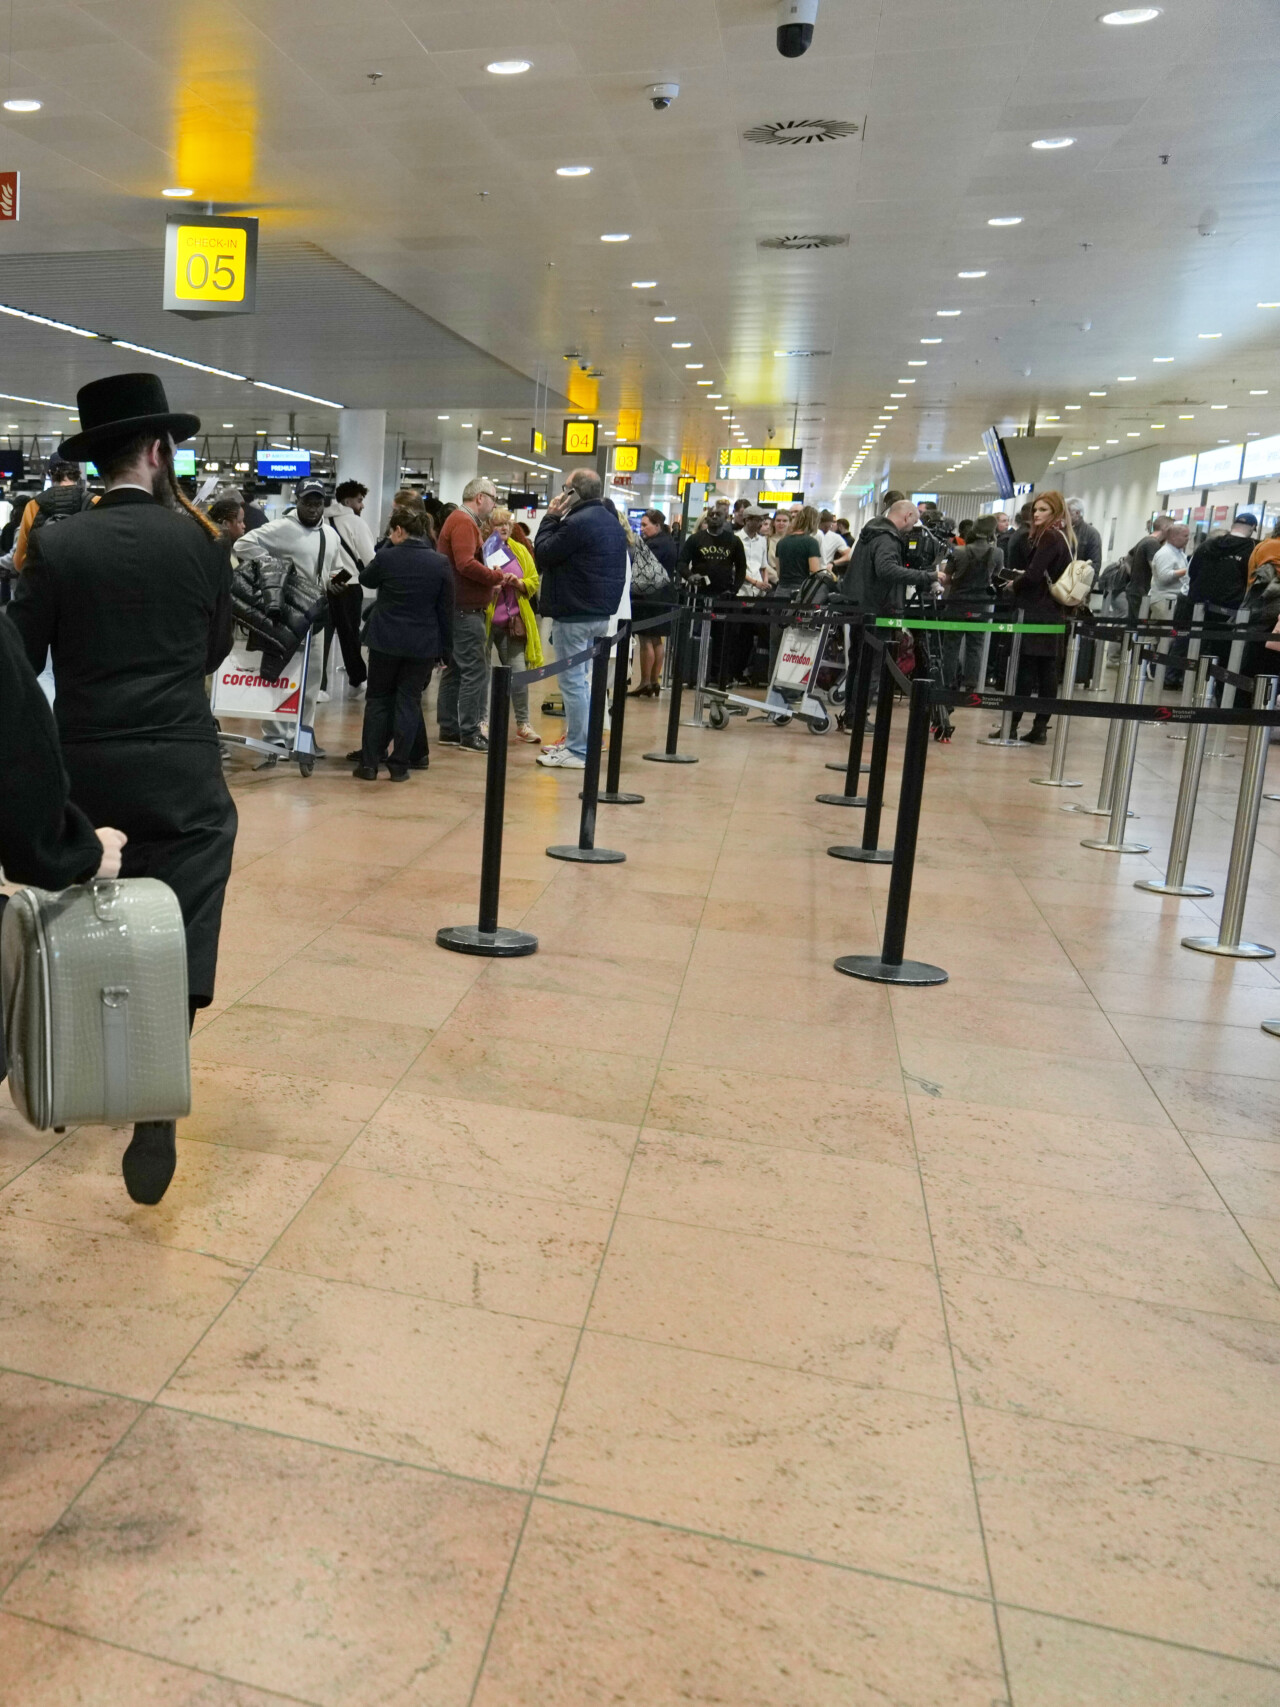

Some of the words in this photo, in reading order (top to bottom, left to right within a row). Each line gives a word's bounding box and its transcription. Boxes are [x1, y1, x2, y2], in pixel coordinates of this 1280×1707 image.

[186, 237, 238, 249] CHECK-IN
[186, 253, 236, 291] 05
[570, 434, 590, 448] 04
[270, 464, 297, 472] PREMIUM
[618, 455, 634, 468] 03
[700, 545, 730, 557] BOSS
[782, 653, 812, 666] corendon
